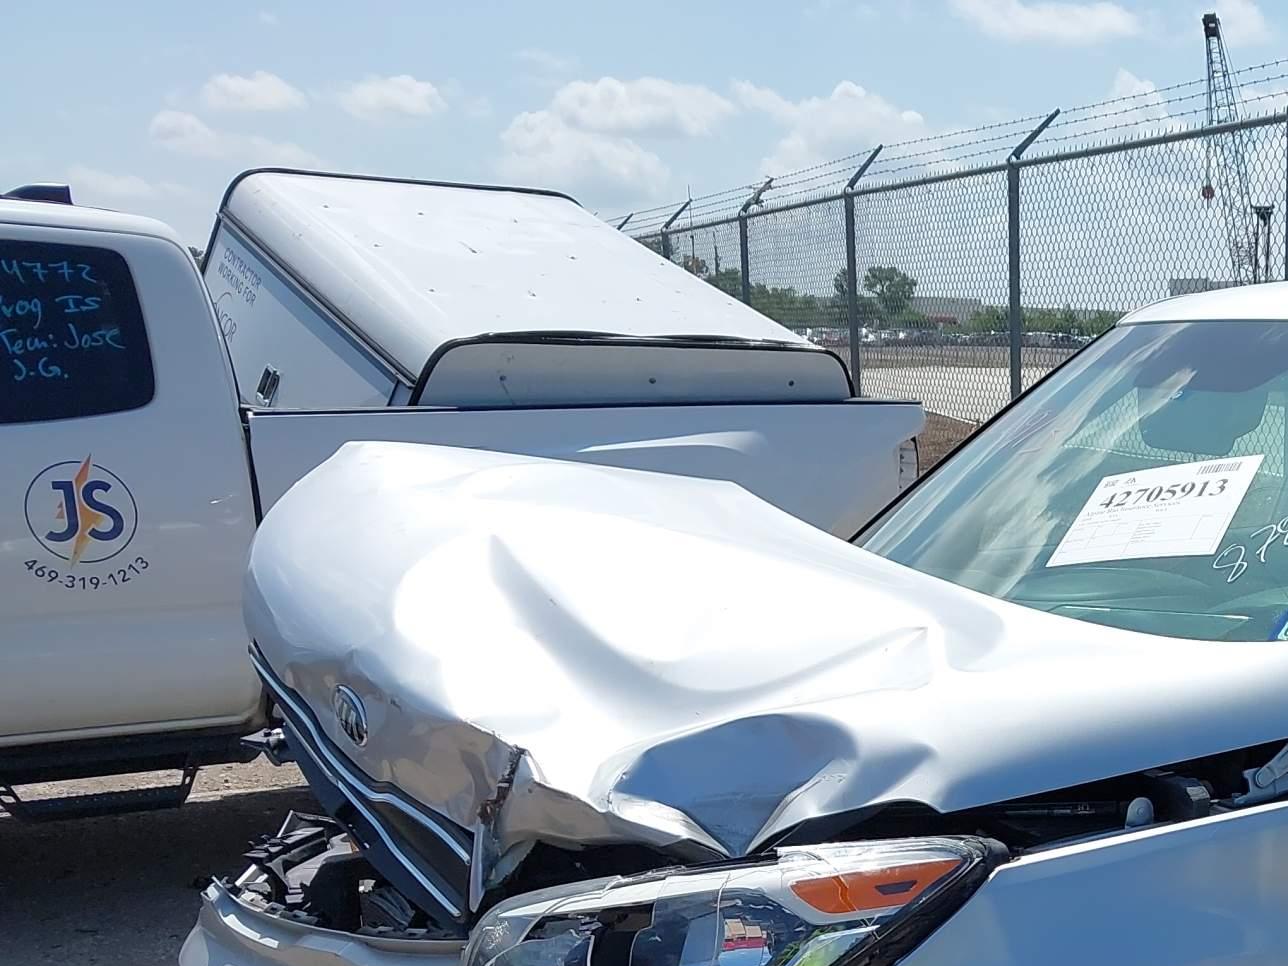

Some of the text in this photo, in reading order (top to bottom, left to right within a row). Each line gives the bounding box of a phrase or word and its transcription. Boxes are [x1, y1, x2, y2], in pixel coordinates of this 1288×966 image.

[224, 247, 262, 290] CONTRACTOR
[243, 286, 257, 306] FOR
[64, 323, 127, 349] Jose
[1099, 478, 1230, 509] 42705913
[44, 480, 124, 542] JS
[24, 556, 149, 591] 469-319-1213
